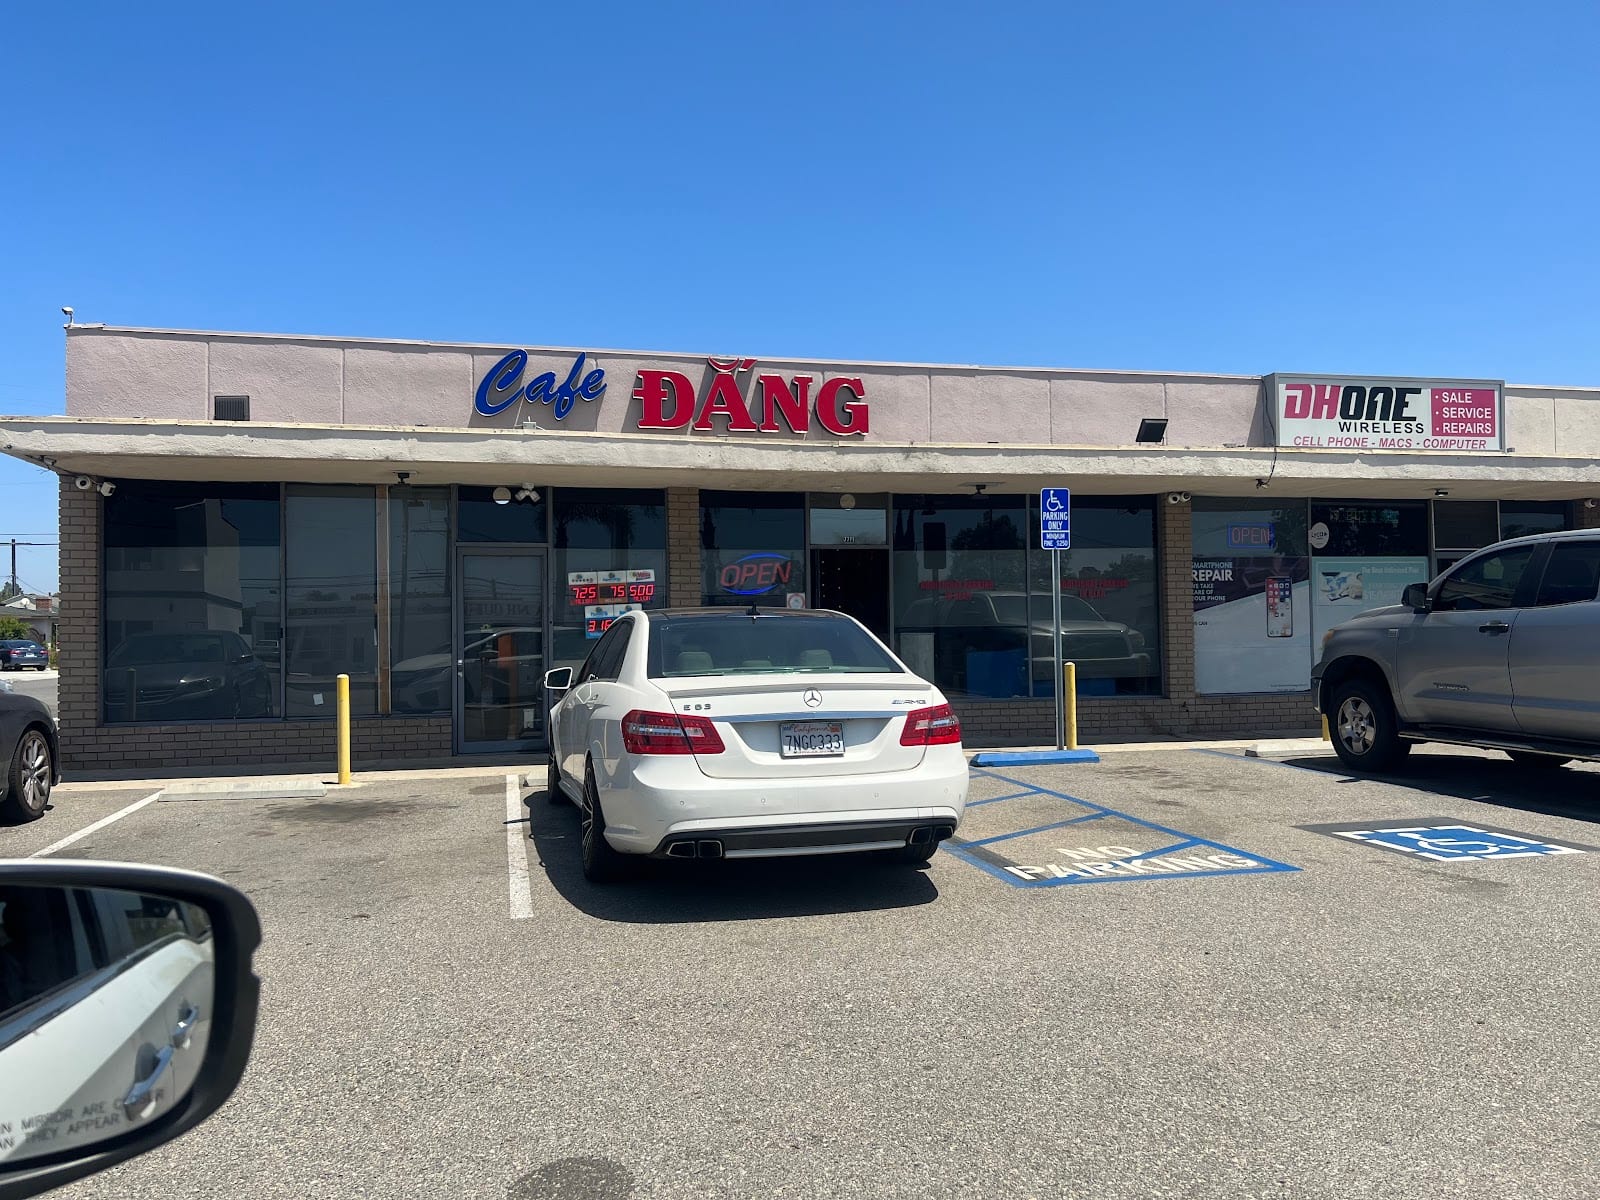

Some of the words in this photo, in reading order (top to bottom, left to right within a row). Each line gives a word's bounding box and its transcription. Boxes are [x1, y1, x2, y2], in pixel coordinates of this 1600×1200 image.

[475, 349, 607, 419] Cafe
[1442, 392, 1472, 404] SALE
[1442, 407, 1492, 419] SERVICE
[1338, 421, 1424, 434] WIRELESS
[1442, 422, 1492, 434] REPAIRS
[1293, 435, 1324, 446] CELL
[1327, 436, 1368, 447] PHONE
[1379, 438, 1412, 448] MACS
[1423, 439, 1487, 449] COMPUTER
[1043, 512, 1068, 520] PARKING
[1048, 521, 1063, 530] ONLY
[1232, 528, 1270, 544] OPEN
[720, 561, 792, 587] OPEN
[1192, 569, 1234, 581] REPAIR
[573, 587, 596, 599] 725
[611, 586, 625, 597] 75
[629, 584, 654, 597] 500
[694, 703, 712, 711] 63
[785, 735, 841, 751] 7NGC333
[1058, 845, 1144, 860] NO
[1003, 854, 1258, 880] PARKING
[82, 1102, 105, 1117] ARE
[67, 1113, 120, 1135] APPEAR
